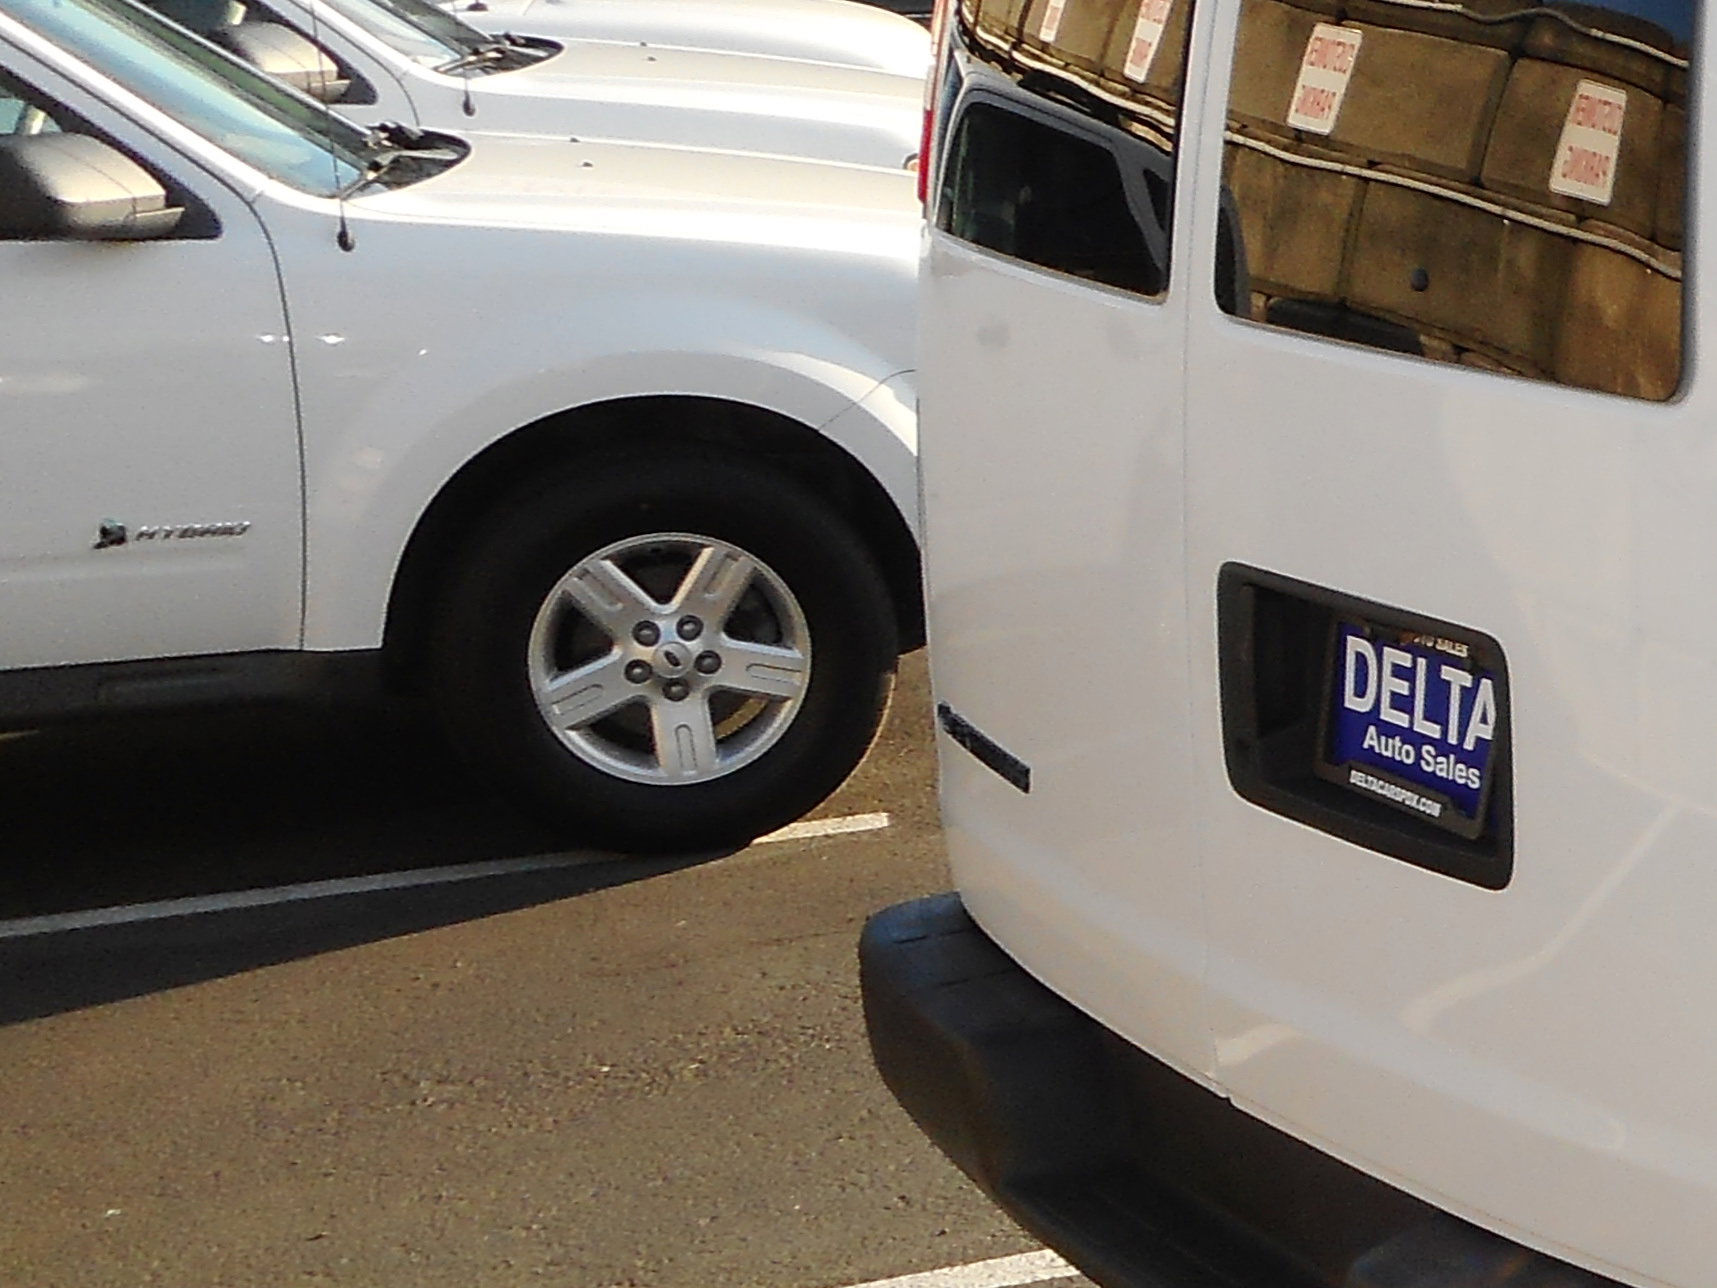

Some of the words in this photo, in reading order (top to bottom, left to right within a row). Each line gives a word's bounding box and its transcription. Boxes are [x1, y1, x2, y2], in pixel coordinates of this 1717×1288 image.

[1344, 634, 1497, 751] DELTA
[1362, 724, 1415, 765] Auto
[1420, 744, 1481, 790] Sales
